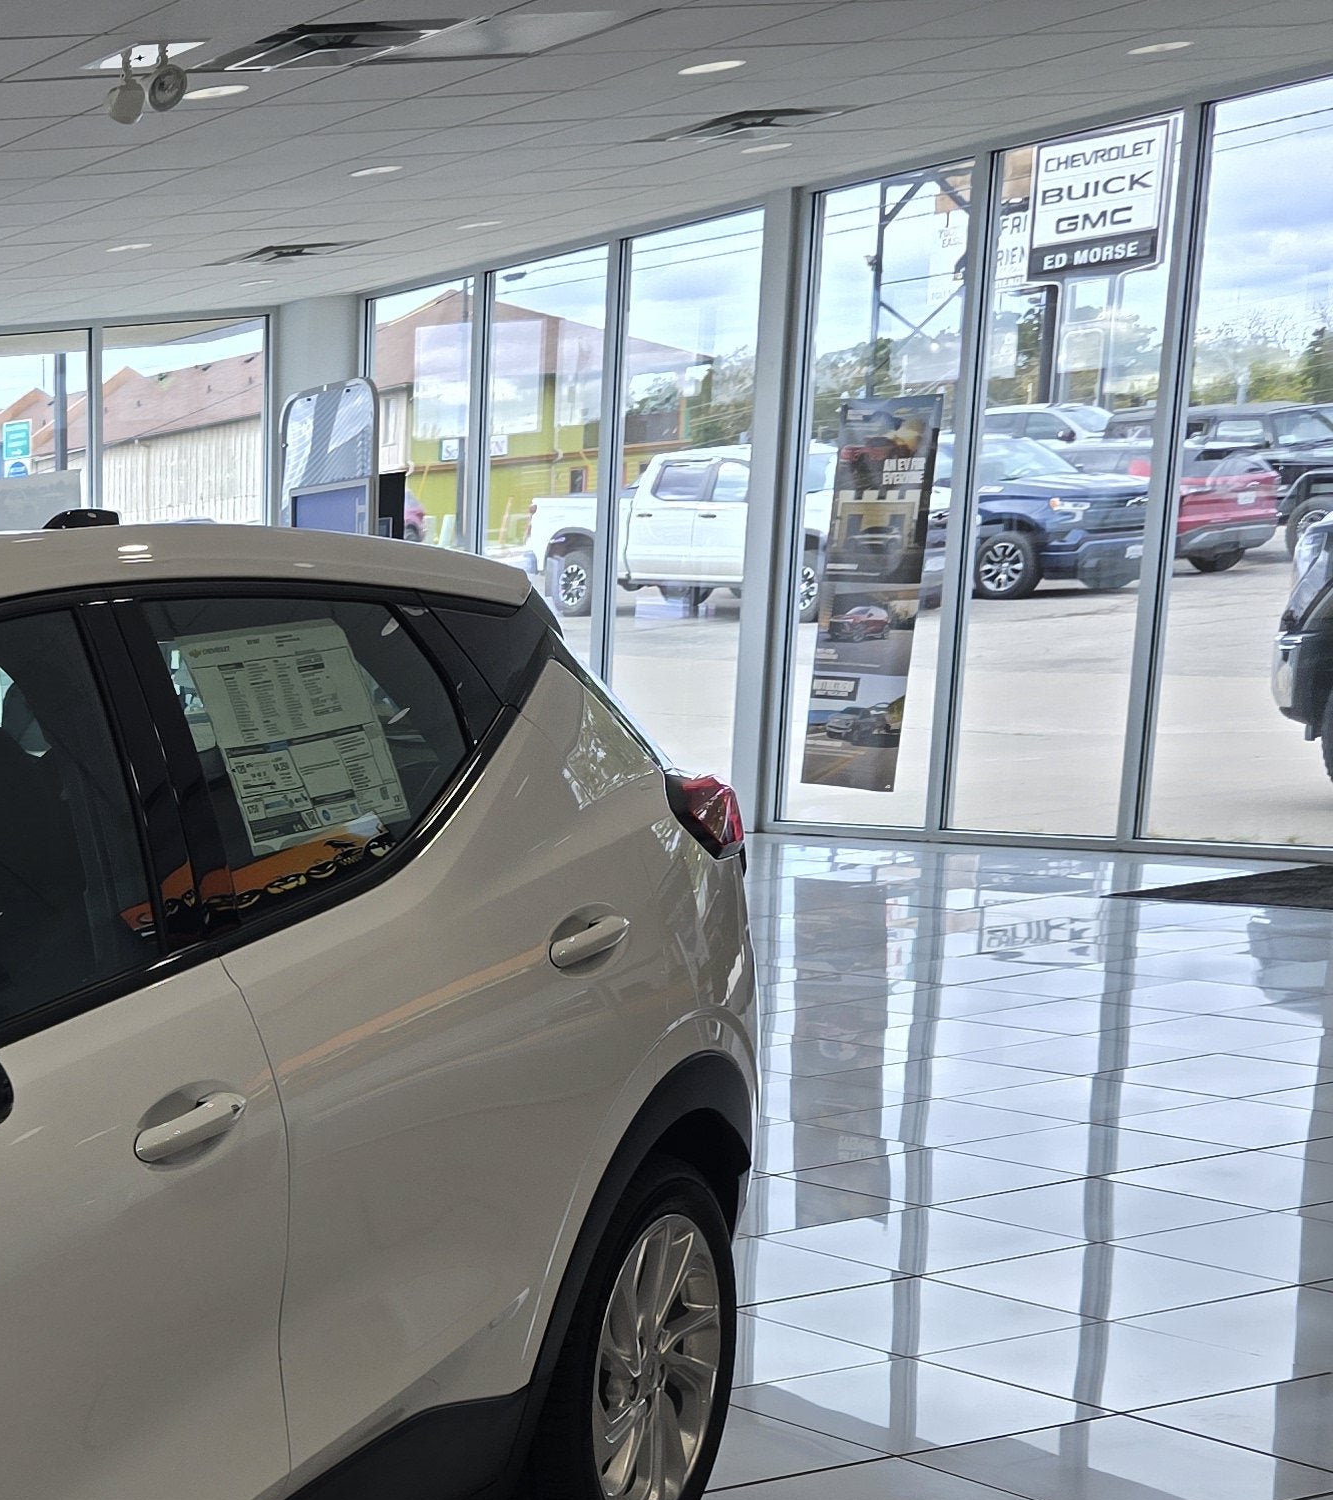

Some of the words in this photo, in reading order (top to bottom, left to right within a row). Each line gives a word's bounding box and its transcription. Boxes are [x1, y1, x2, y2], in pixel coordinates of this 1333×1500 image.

[1044, 138, 1156, 173] CHEVROLET
[1041, 170, 1154, 206] BUICK
[1055, 206, 1134, 234] GMC
[1042, 252, 1068, 271] ED
[1073, 241, 1139, 266] MORSE
